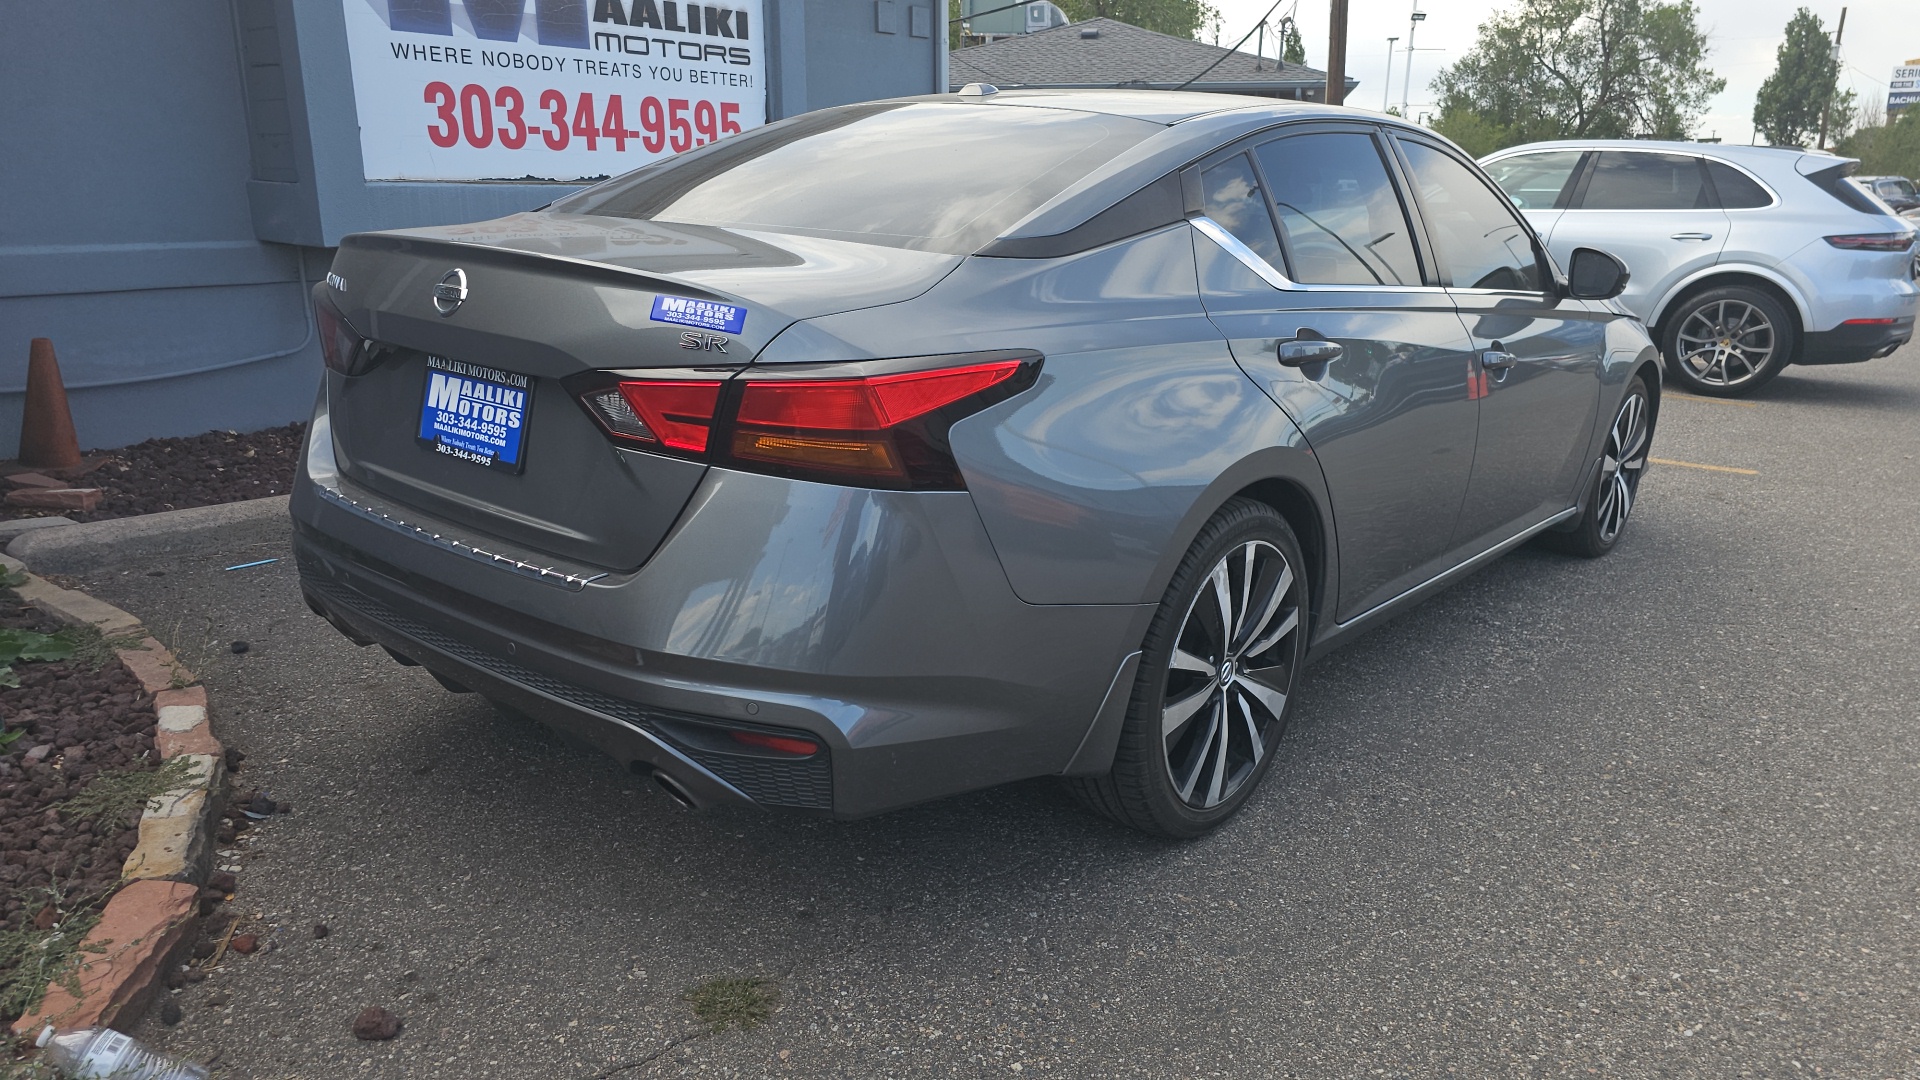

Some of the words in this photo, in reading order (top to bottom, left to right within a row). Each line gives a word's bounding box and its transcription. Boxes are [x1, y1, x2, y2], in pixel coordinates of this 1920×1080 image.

[594, 31, 751, 66] MOTORS
[389, 42, 473, 65] WHERE
[481, 50, 567, 73] NOBODY
[573, 58, 642, 79] TREATS
[648, 65, 683, 82] YOU
[689, 69, 754, 88] BETTER!
[1895, 69, 1920, 78] SERI
[1889, 96, 1920, 104] BACHU
[423, 81, 743, 154] 303-344-9595
[666, 311, 725, 326] 303-344-9595
[679, 331, 729, 354] SR
[426, 355, 467, 374] MAALIKI
[433, 421, 507, 447] MAALIKIMOTORS.COM
[435, 411, 507, 438] 303-344-9595
[435, 443, 492, 466] 303-344-9595
